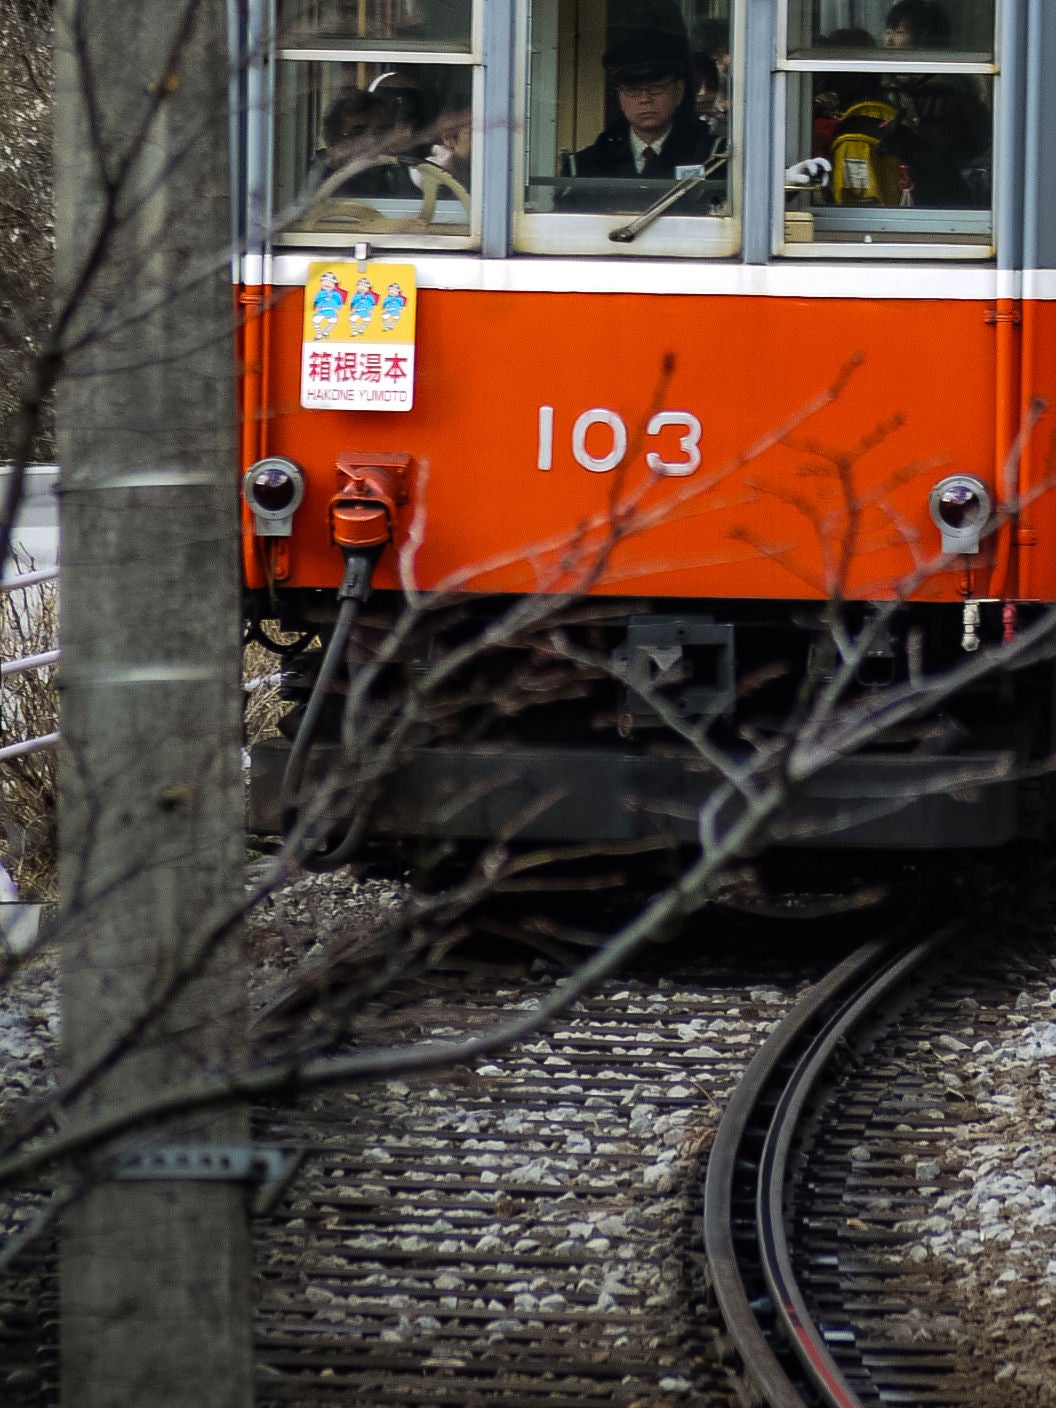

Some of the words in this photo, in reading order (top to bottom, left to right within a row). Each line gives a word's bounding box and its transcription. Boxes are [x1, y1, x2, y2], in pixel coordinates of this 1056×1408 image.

[308, 351, 408, 384] 箱根湯本
[307, 388, 355, 401] HAKONE
[360, 389, 408, 402] YUMOTO
[537, 405, 702, 477] 103
